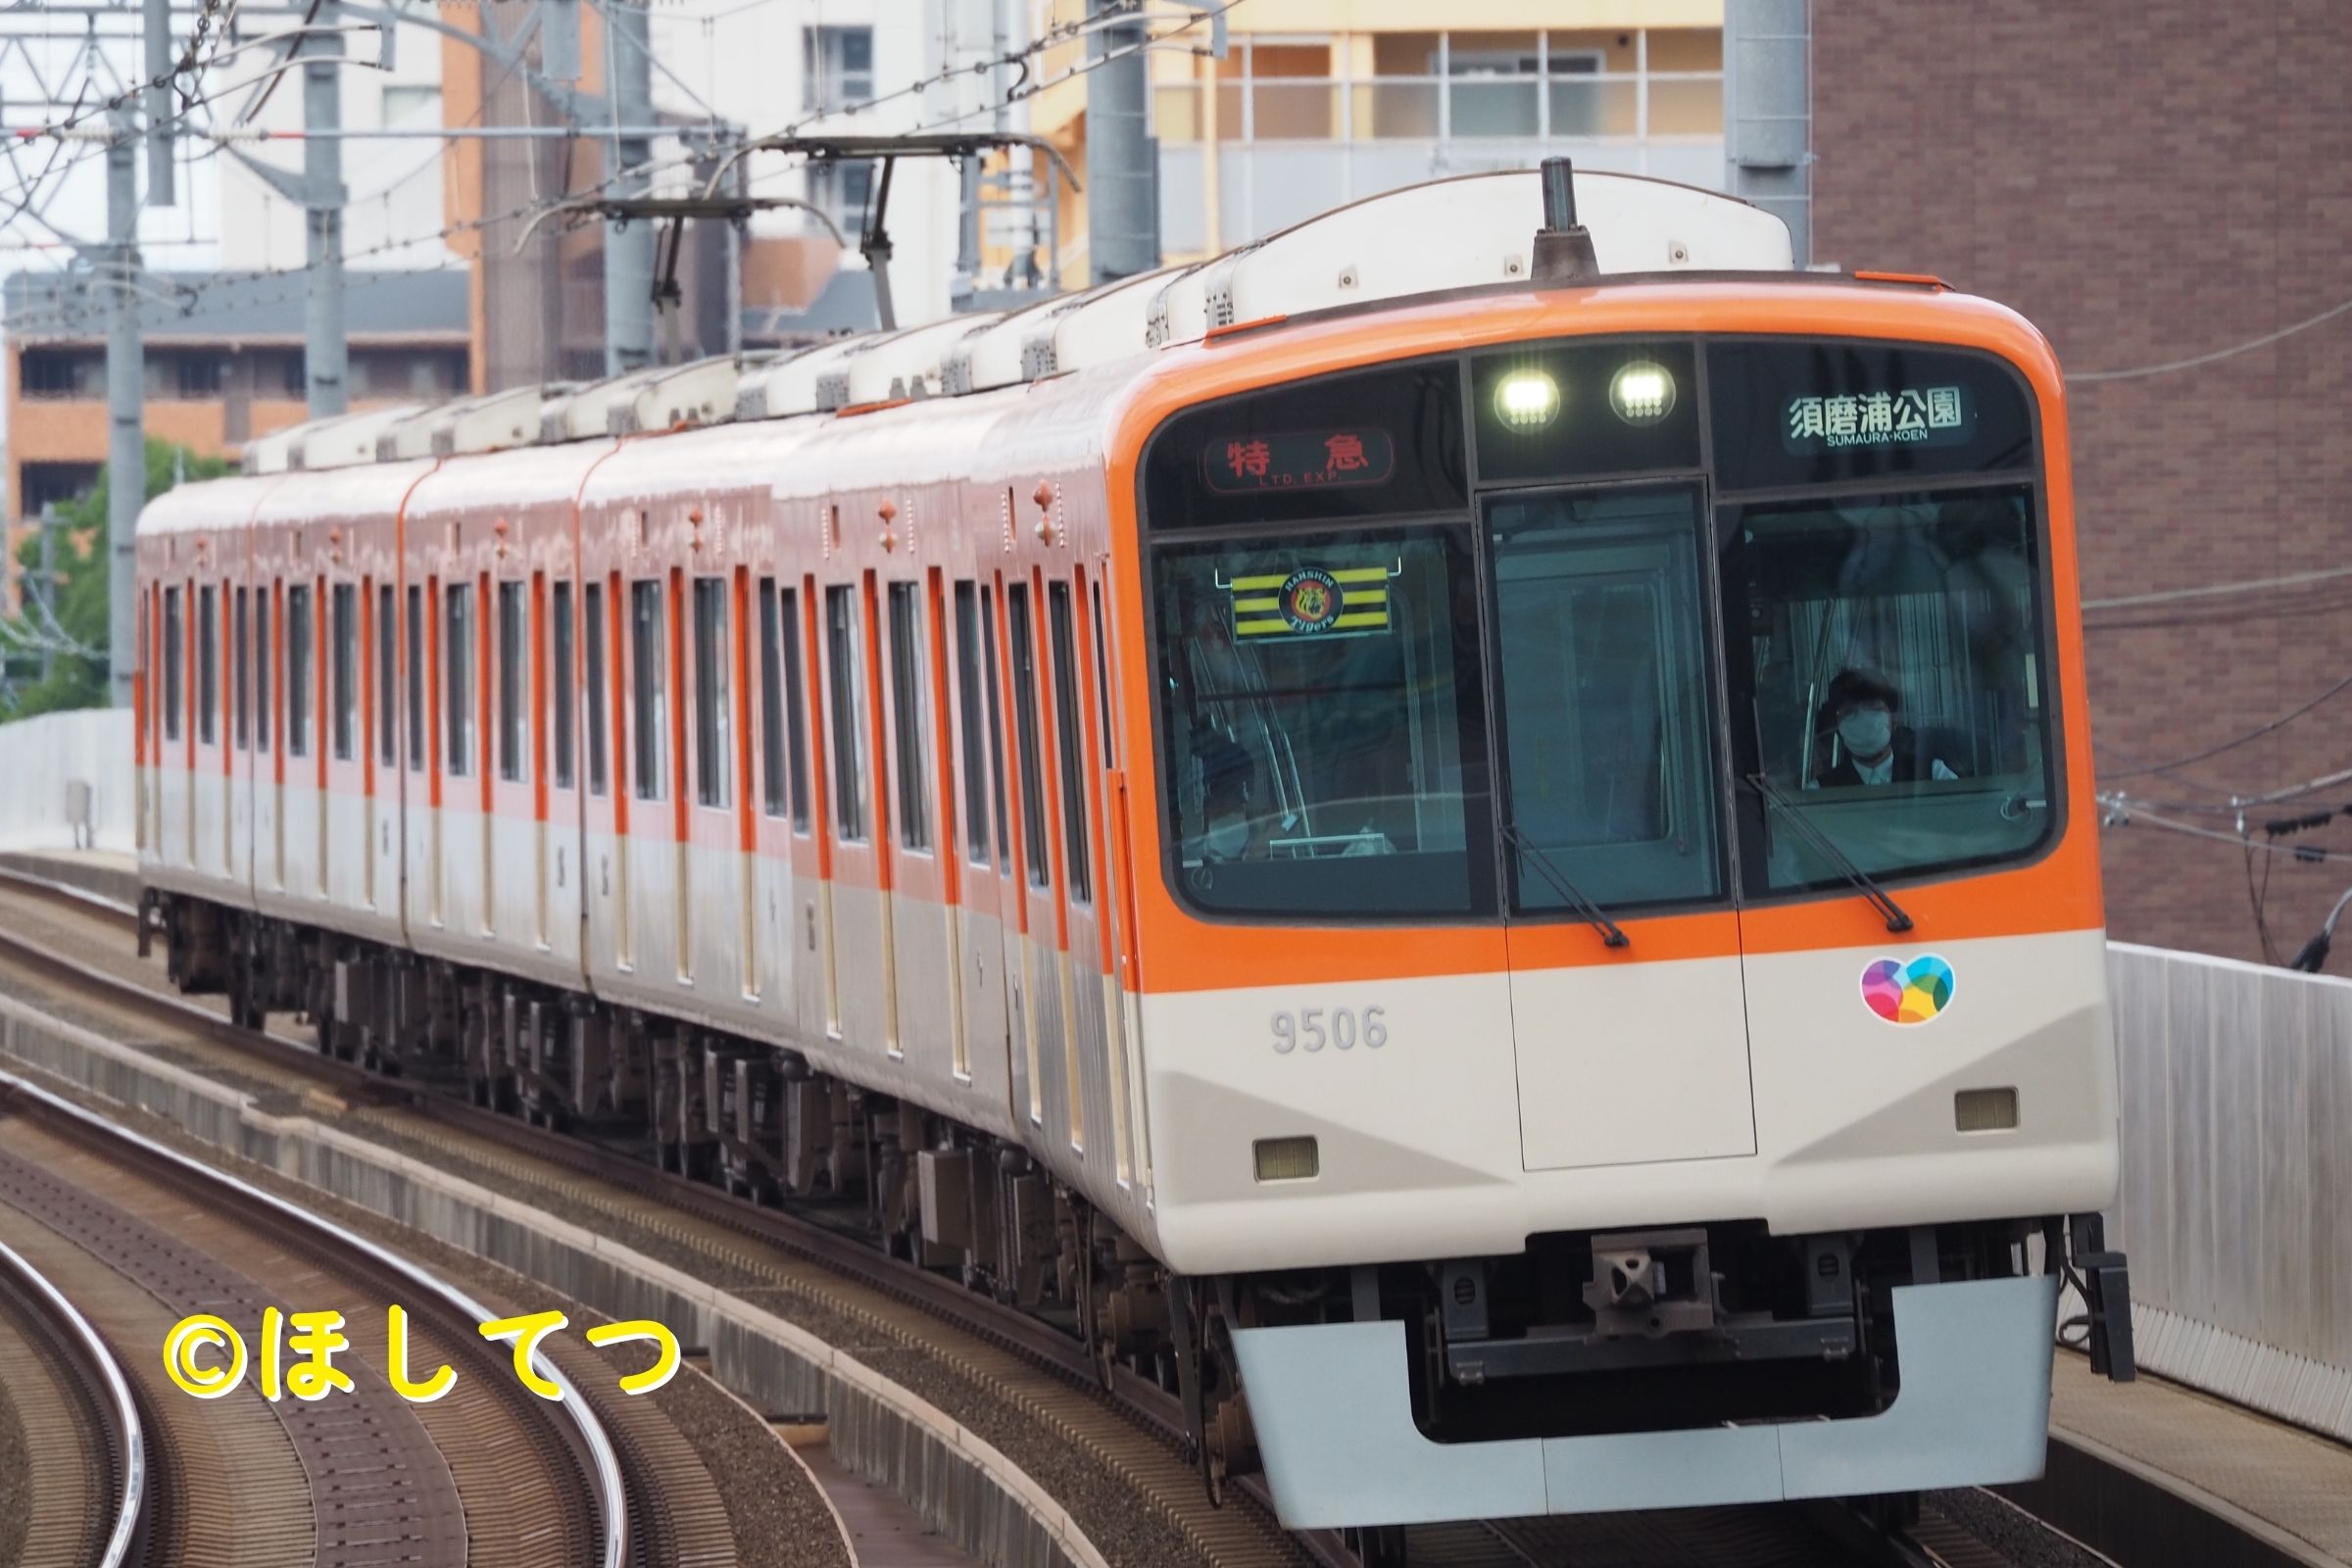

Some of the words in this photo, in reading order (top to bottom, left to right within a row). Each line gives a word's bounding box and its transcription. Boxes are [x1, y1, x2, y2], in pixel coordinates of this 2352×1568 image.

[1788, 386, 1962, 439] 須磨浦公園
[1259, 473, 1297, 487] LTD.
[1303, 469, 1342, 483] EXP.
[1285, 570, 1334, 592] HANSHIN
[1270, 1004, 1388, 1054] 9506
